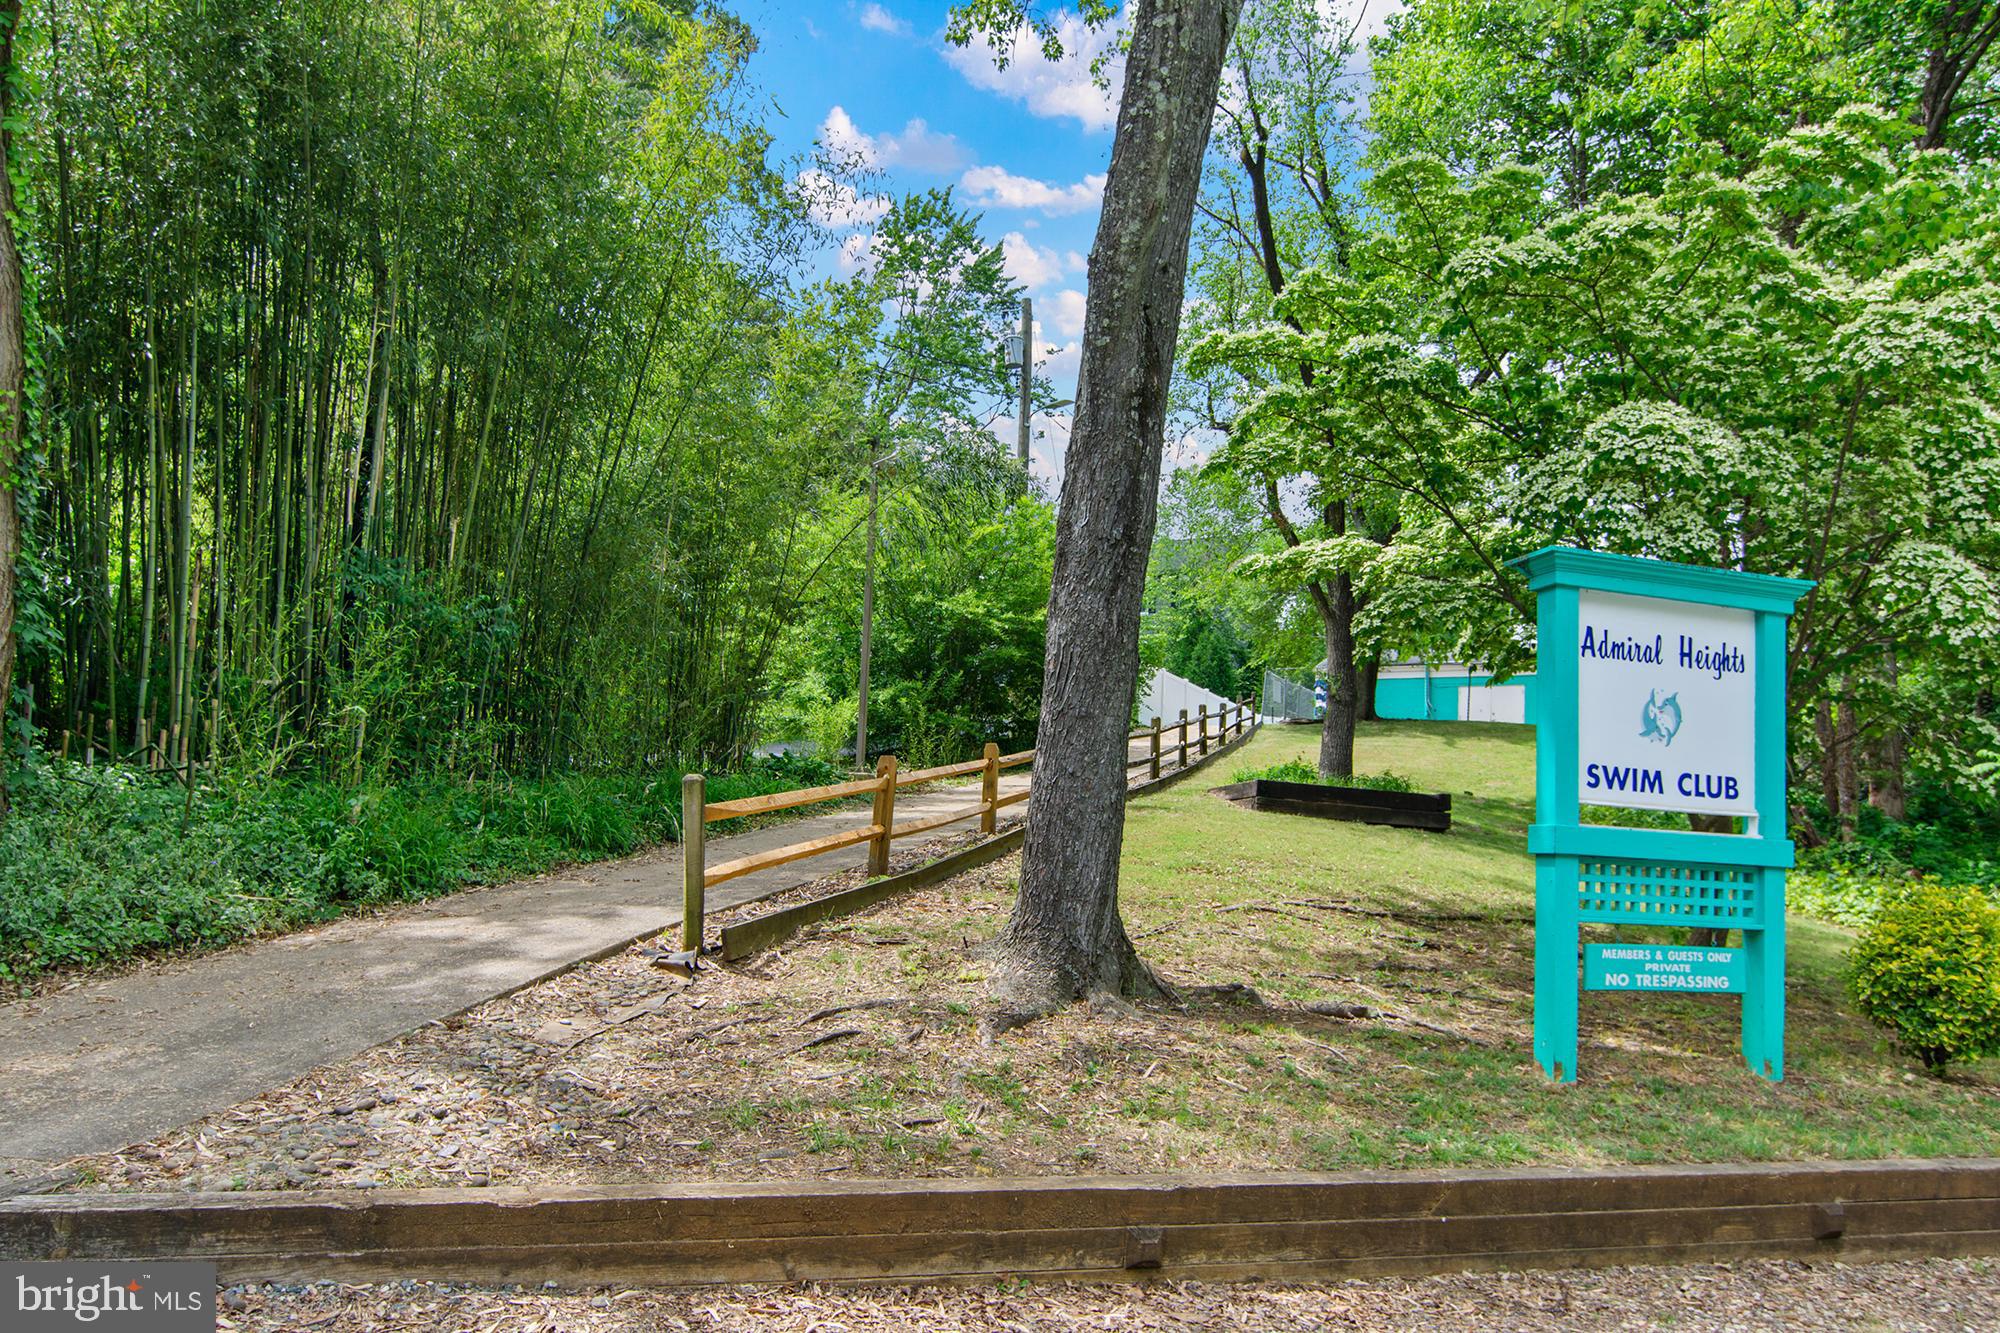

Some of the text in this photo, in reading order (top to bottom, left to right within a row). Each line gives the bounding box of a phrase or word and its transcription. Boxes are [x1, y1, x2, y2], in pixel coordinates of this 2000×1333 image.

[1580, 626, 1745, 680] Admiral Heights
[1586, 763, 1739, 800] SWIM CLUB
[1602, 949, 1732, 962] MEMBERS & GUESTS ONLY
[1645, 963, 1691, 973] PRIVATE
[1605, 973, 1729, 988] NO TRESPASSING
